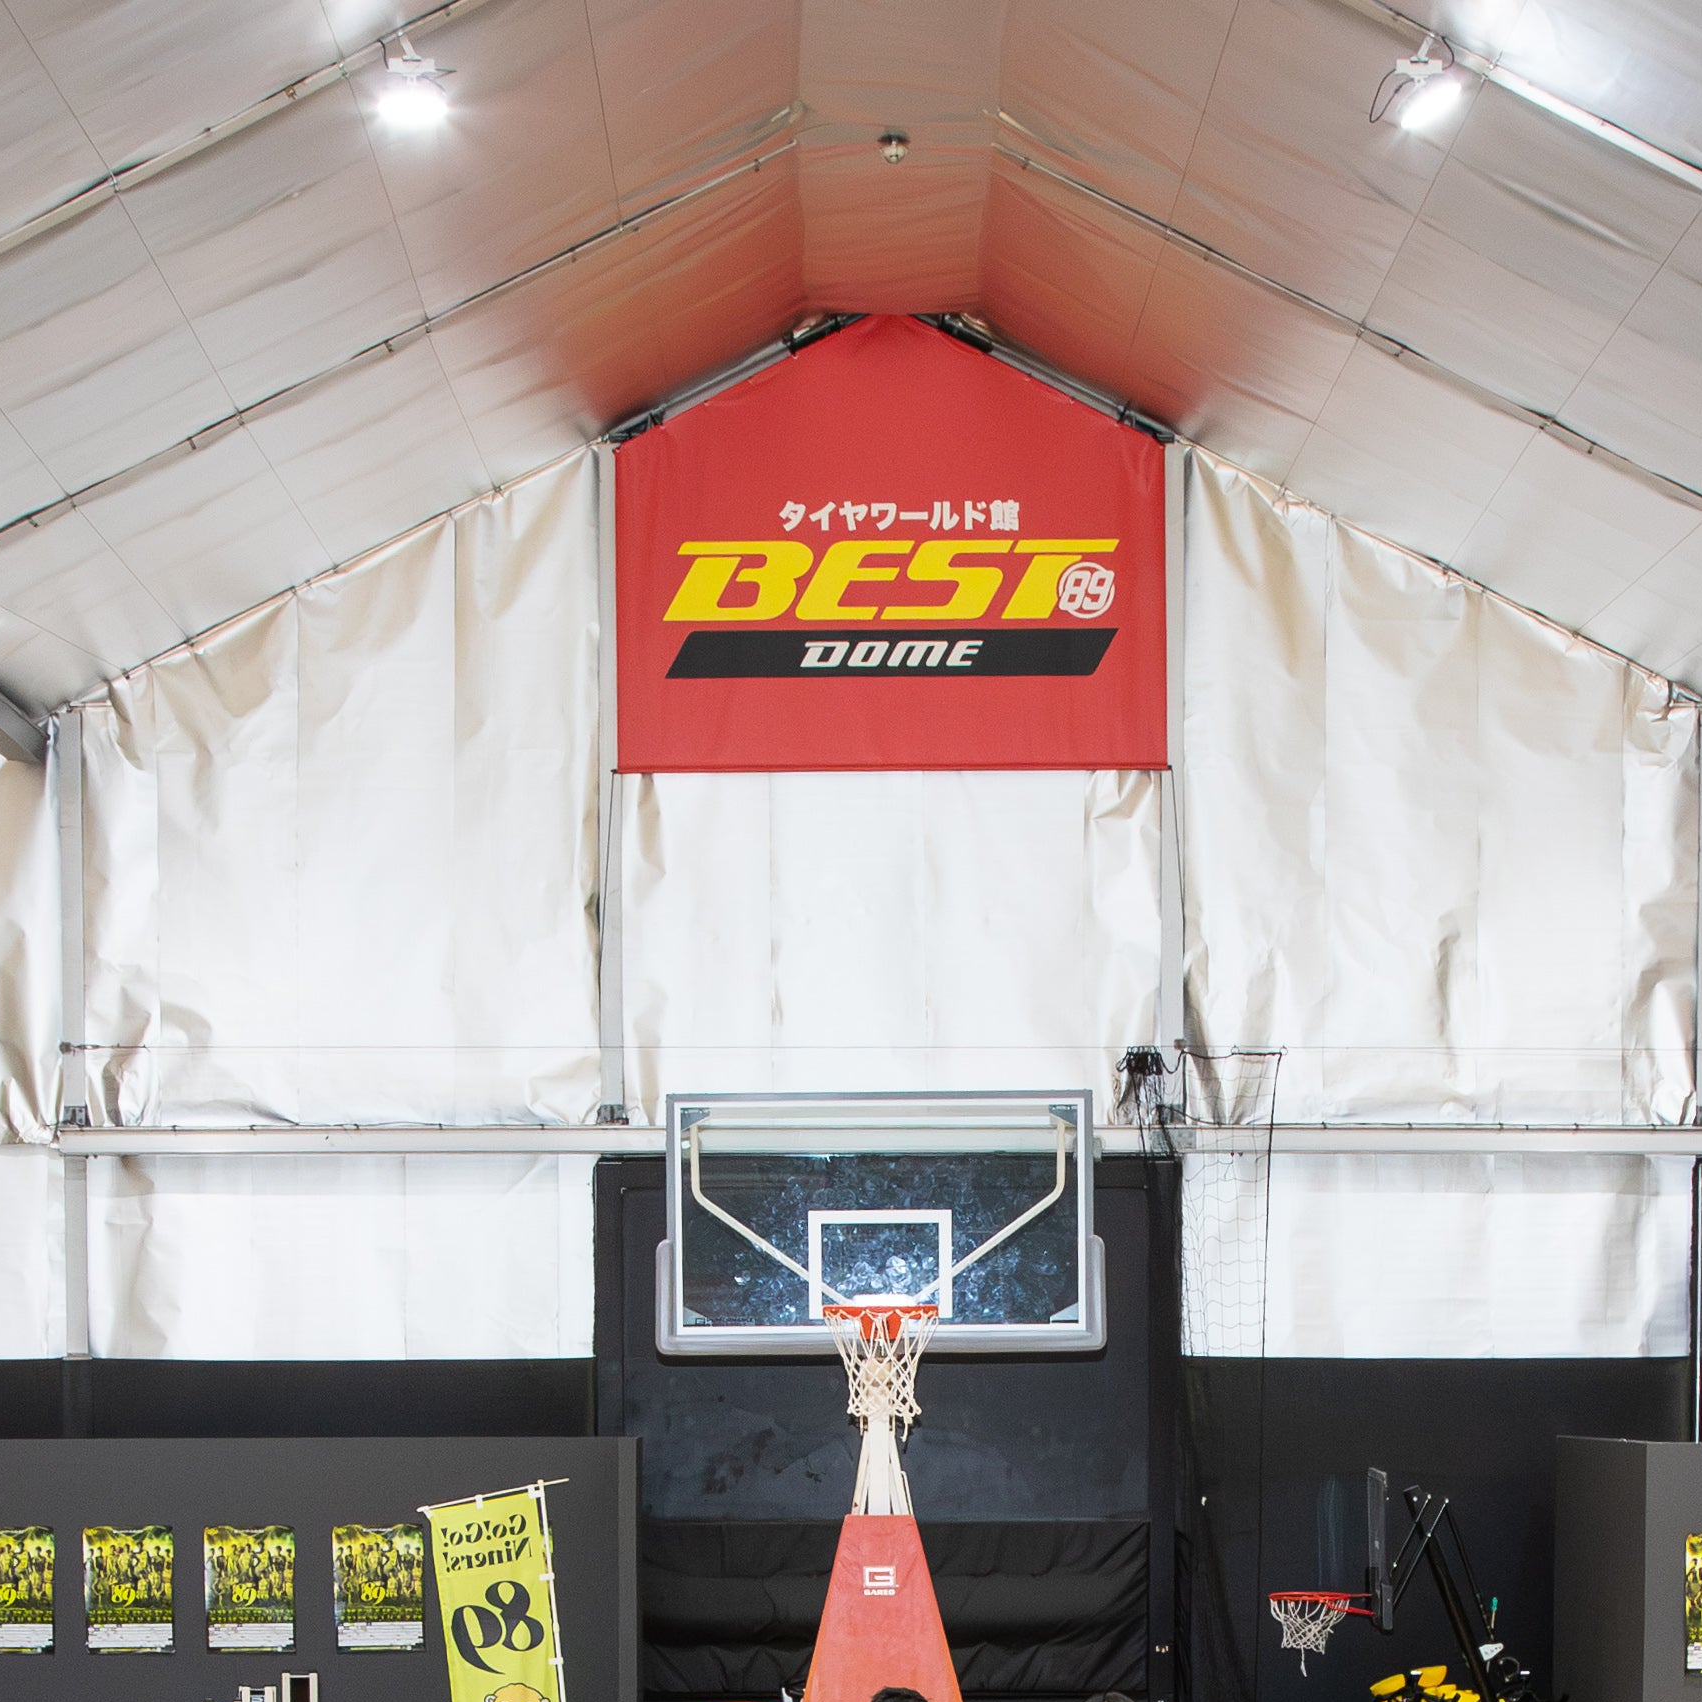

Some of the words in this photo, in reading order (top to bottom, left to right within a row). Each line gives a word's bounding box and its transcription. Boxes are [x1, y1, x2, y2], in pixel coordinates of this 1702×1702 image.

[779, 501, 1019, 531] タイヤワールド館
[663, 539, 1119, 621] BEST
[800, 640, 983, 667] DOME
